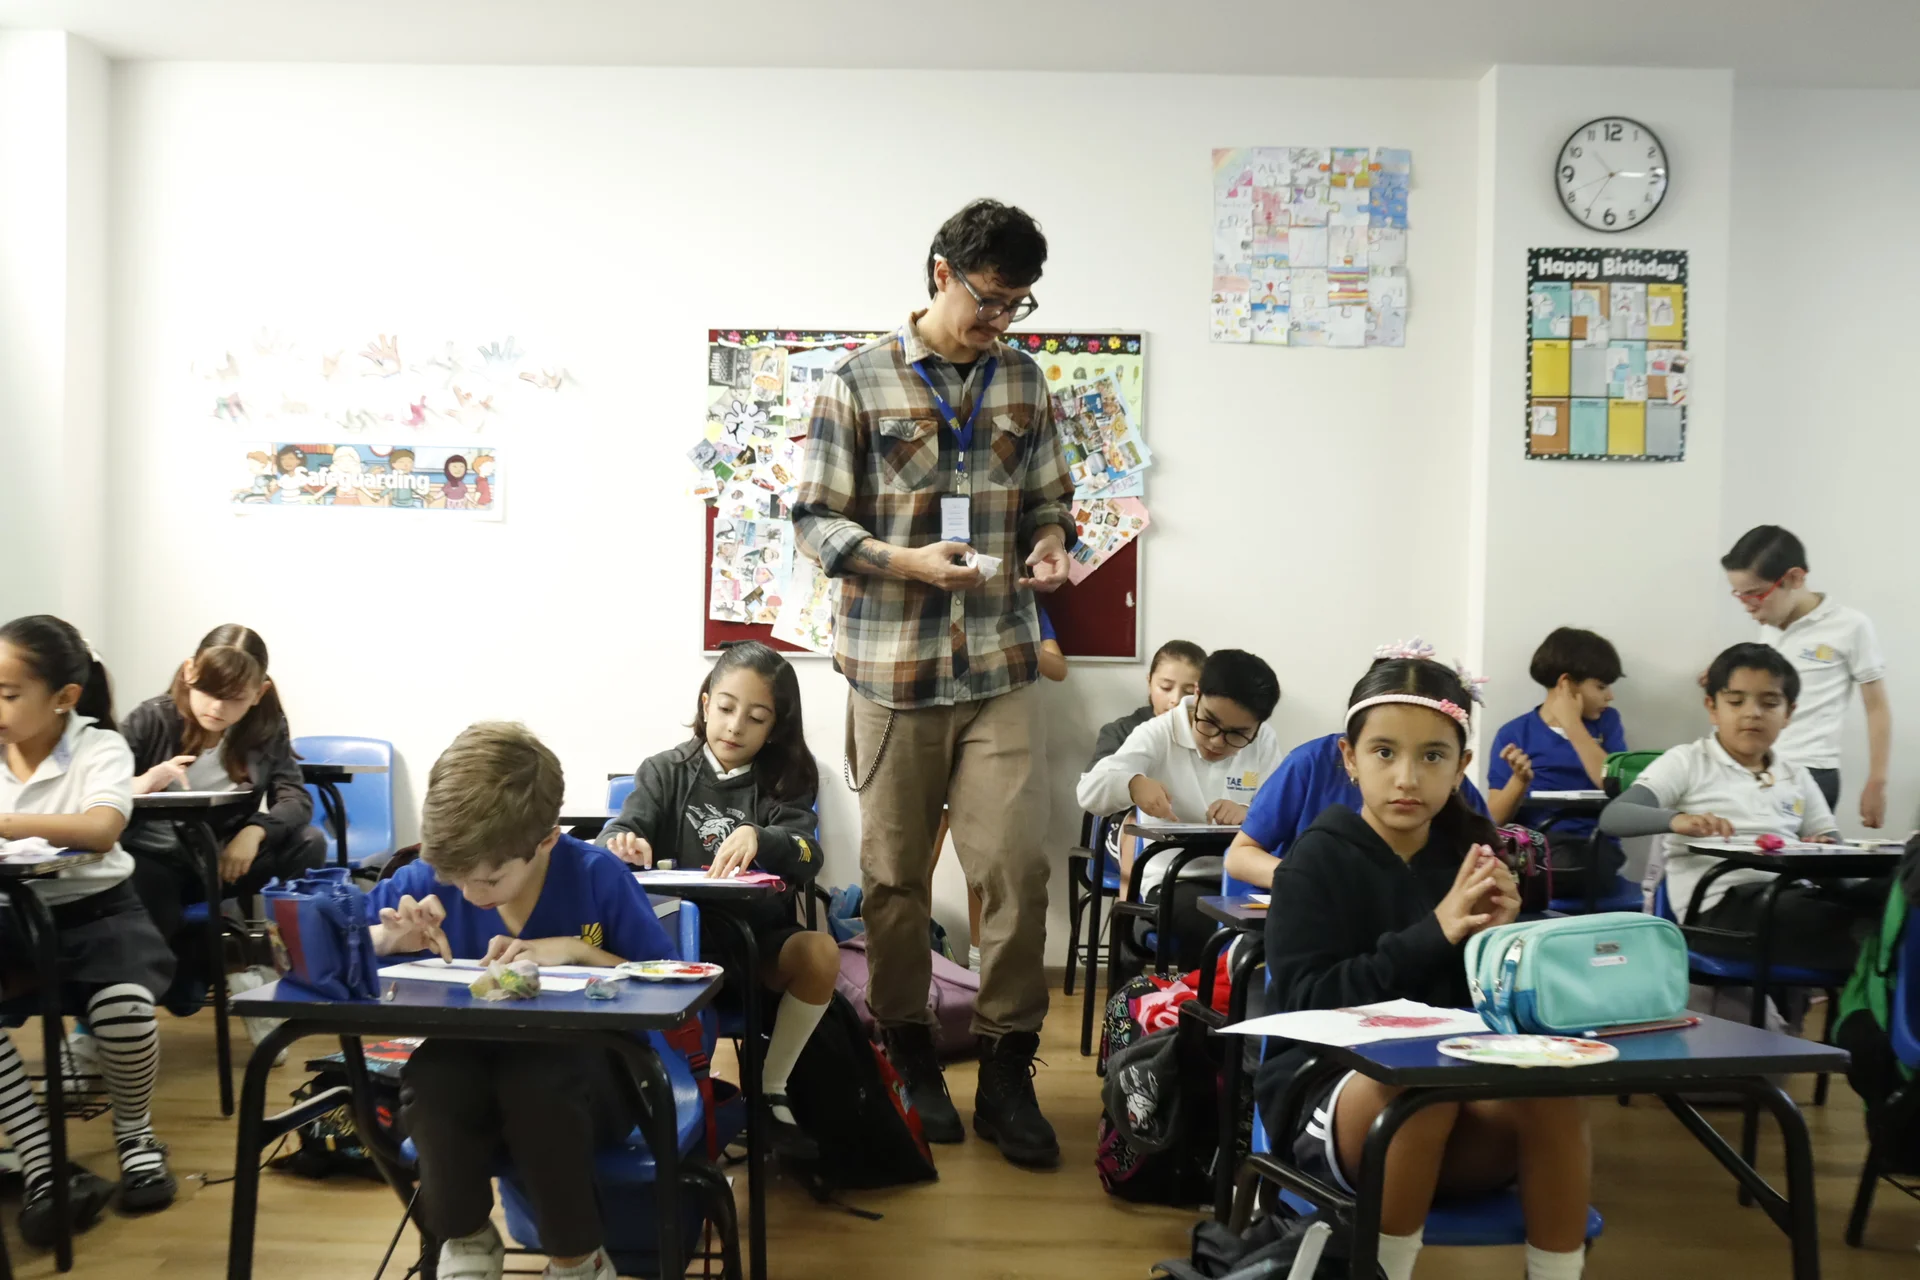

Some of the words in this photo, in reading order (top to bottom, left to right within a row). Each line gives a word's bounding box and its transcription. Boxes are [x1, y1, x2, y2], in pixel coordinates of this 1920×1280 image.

[1587, 129, 1596, 141] 11
[1604, 123, 1623, 141] 12
[1633, 129, 1639, 142] 1
[1570, 147, 1583, 159] 10
[1647, 147, 1657, 158] 2
[1561, 165, 1575, 183] 9
[1567, 191, 1576, 203] 8
[1584, 208, 1592, 220] 7
[1603, 208, 1616, 226] 6
[1628, 209, 1636, 221] 5
[1538, 257, 1599, 279] Happy
[1602, 256, 1679, 281] Birthday
[294, 466, 430, 494] Safeguarding
[1226, 777, 1242, 786] TAE
